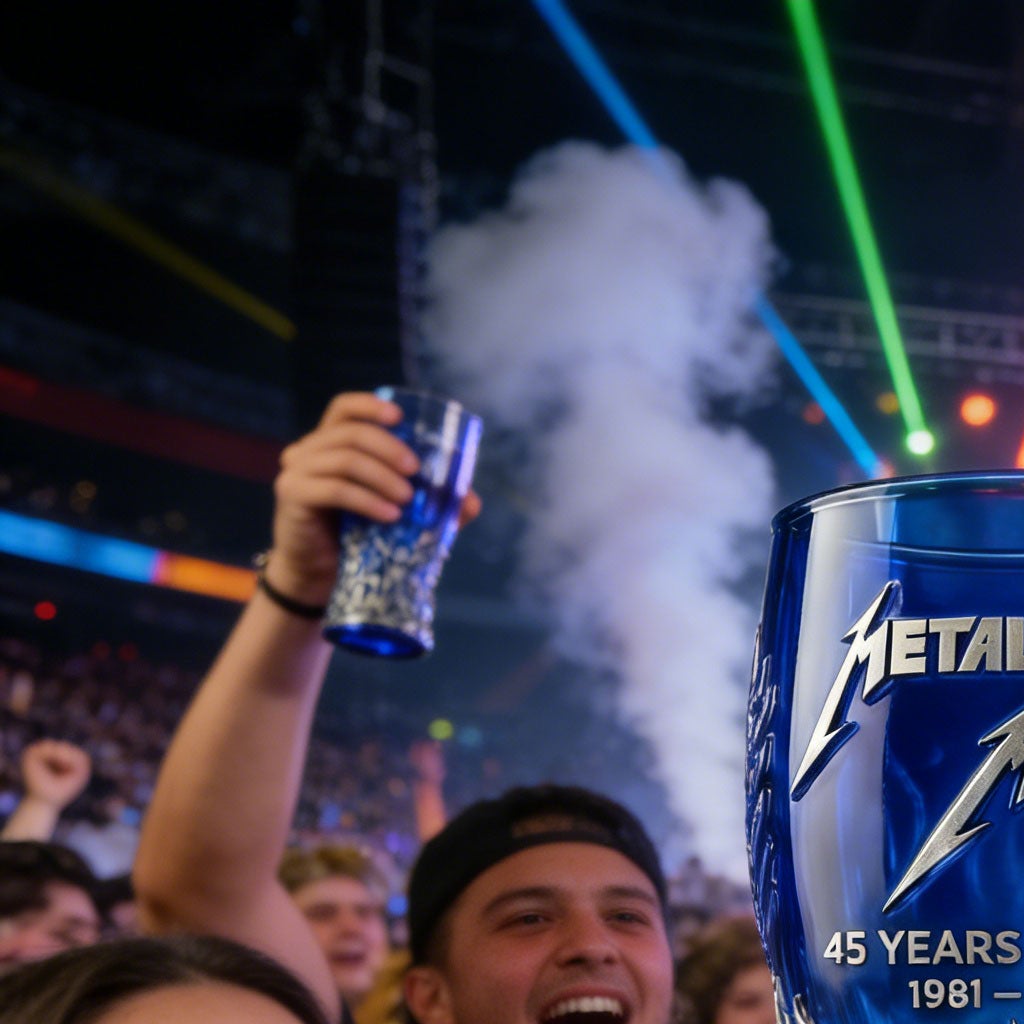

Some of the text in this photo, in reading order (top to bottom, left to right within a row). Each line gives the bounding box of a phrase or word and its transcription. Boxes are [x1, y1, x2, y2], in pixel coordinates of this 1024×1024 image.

[823, 930, 867, 966] 45
[876, 930, 1023, 966] YEARS
[908, 978, 982, 1009] 1981
